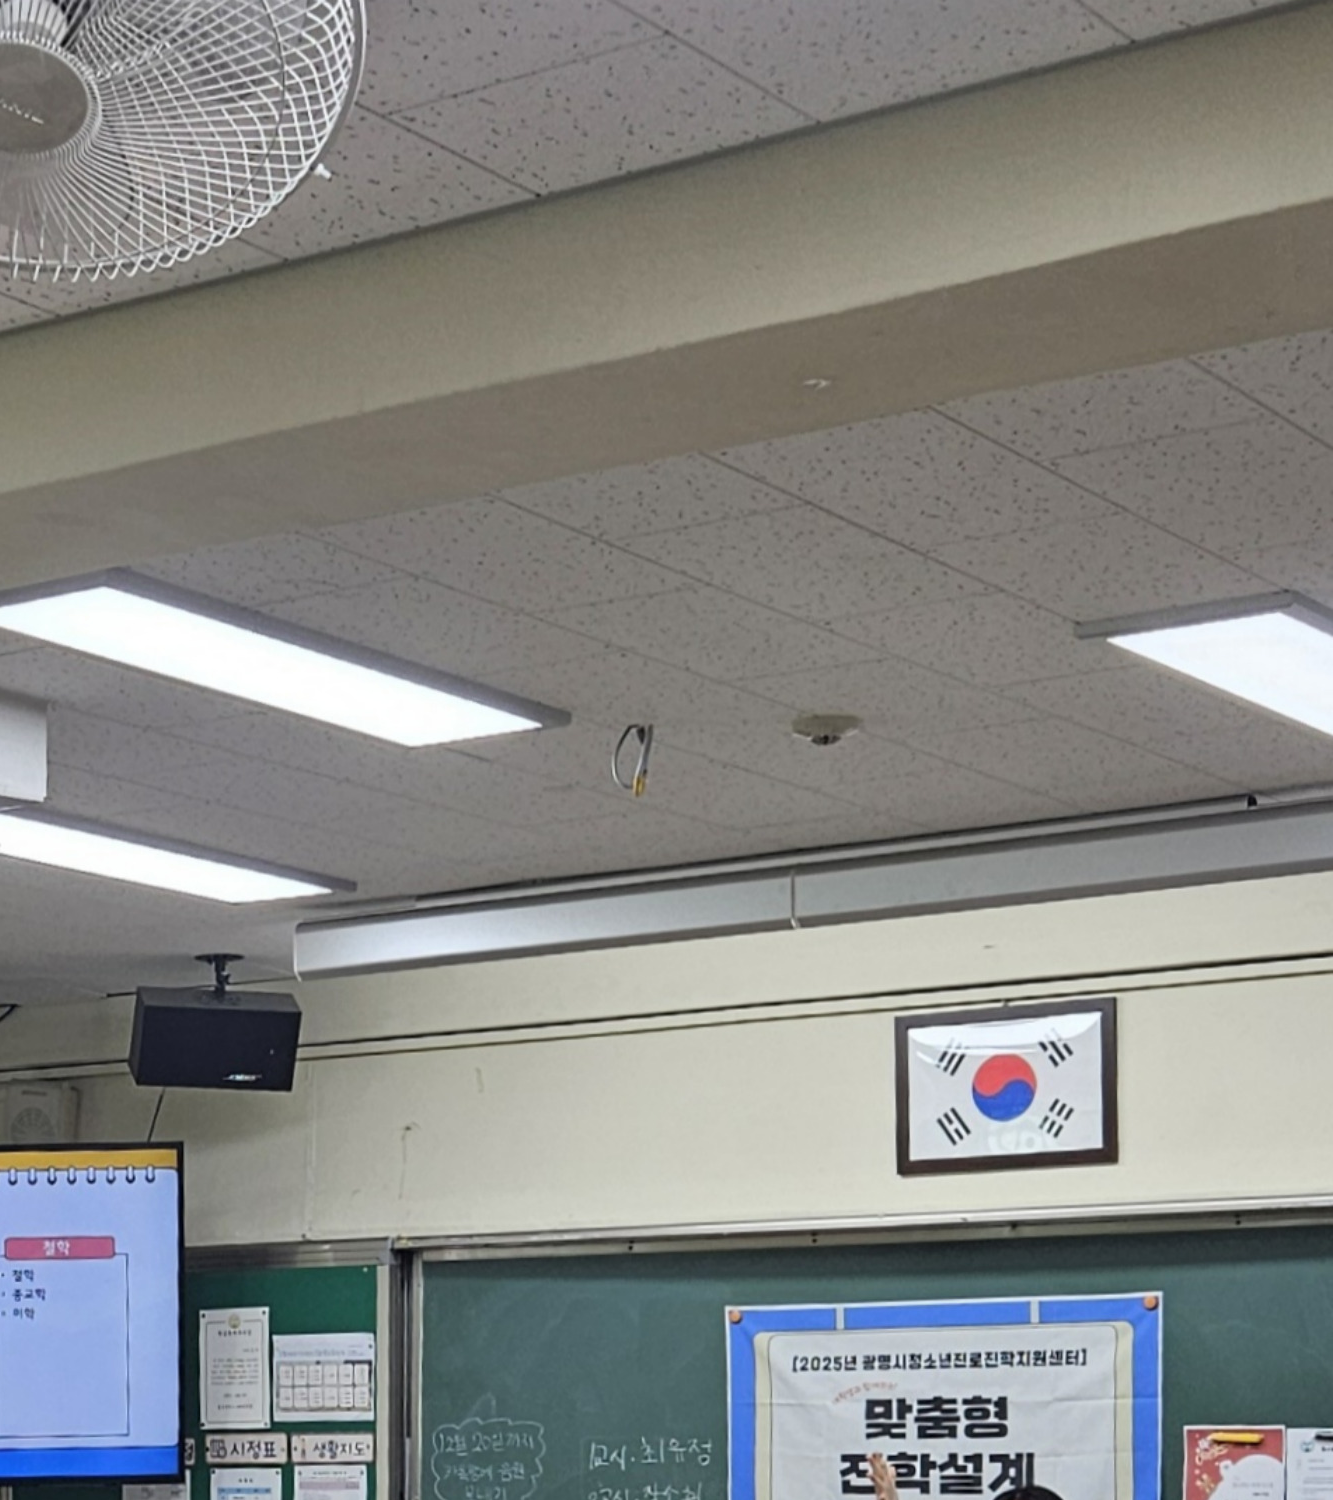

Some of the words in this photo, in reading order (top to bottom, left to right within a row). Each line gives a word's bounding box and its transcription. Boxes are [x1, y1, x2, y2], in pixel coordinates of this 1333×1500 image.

[43, 1240, 71, 1257] 철학
[792, 1354, 857, 1373] [2025년
[864, 1396, 1009, 1440] 맞춤형
[230, 1440, 278, 1460] 시정표
[313, 1439, 366, 1460] 생활지도
[839, 1452, 1035, 1495] 진학설계
